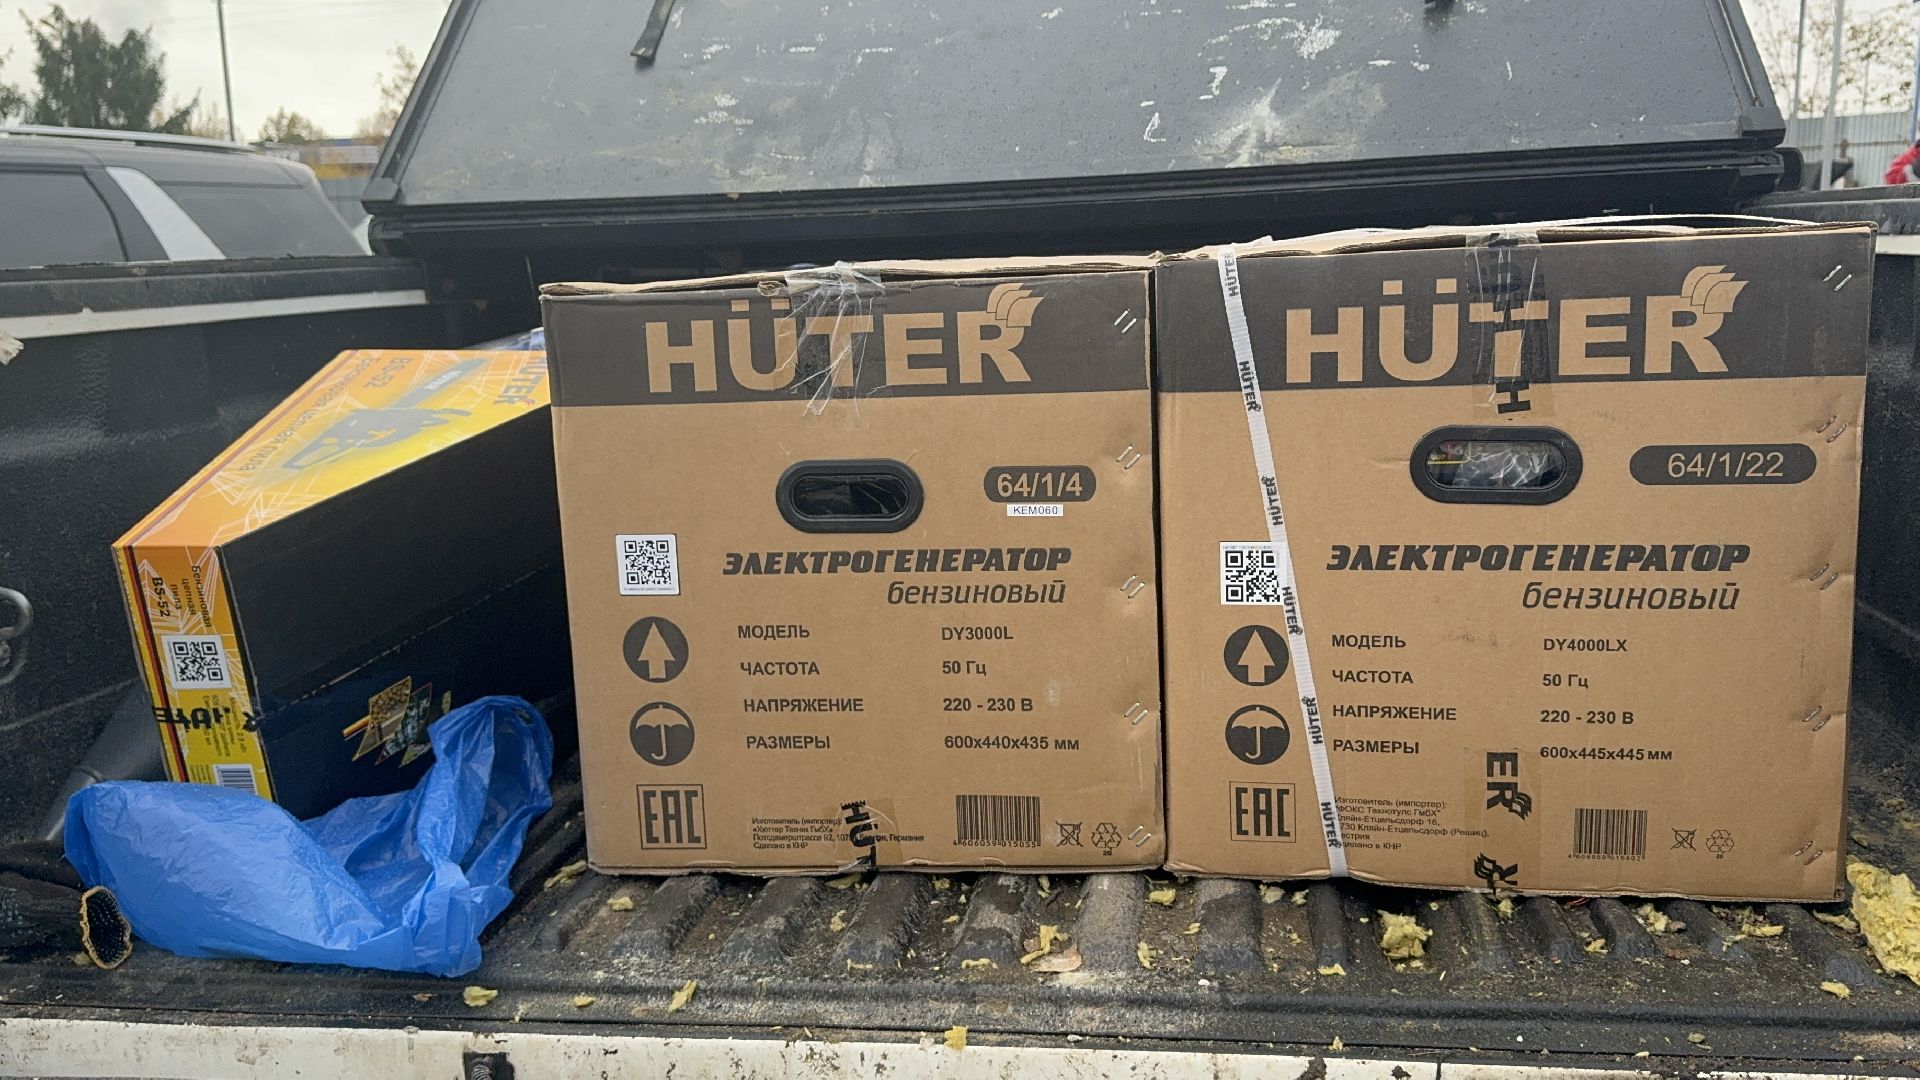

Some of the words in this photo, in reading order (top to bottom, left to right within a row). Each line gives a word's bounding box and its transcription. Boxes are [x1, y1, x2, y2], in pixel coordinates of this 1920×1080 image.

[1286, 265, 1749, 384] HÜTER
[645, 282, 1044, 393] HÜTER
[1238, 360, 1262, 412] HÜTER
[1667, 453, 1785, 478] 64/1/22
[997, 472, 1082, 498] 64/1/4
[1261, 476, 1284, 526] HÜTER
[723, 547, 1071, 576] ЭЛЕКТРОГЕНЕРАТОР
[1326, 543, 1750, 572] ЭЛЕКТРОГЕНЕРАТОР
[152, 576, 171, 617] BS-52
[888, 580, 1066, 605] бензиновый
[1523, 581, 1739, 610] бензиновый
[1281, 586, 1304, 636] HÜTER
[738, 624, 810, 641] МОДЕЛЬ
[942, 626, 1014, 641] DY3000L
[1332, 634, 1407, 650] МОДЕЛЬ
[1544, 638, 1628, 652] DY4000LX
[741, 661, 820, 676] ЧАСТОТА
[943, 661, 962, 675] 50
[966, 661, 987, 677] Гц
[1333, 669, 1414, 684] ЧАСТОТА
[1543, 674, 1562, 687] 50
[1568, 674, 1589, 690] Гц
[744, 698, 864, 713] НАПРЯЖЕНИЕ
[943, 698, 972, 712] 220
[987, 698, 1016, 712] 230
[1333, 705, 1457, 721] НАПРЯЖЕНИЕ
[1301, 695, 1324, 744] HÜTER
[1540, 710, 1571, 724] 220
[1587, 710, 1616, 725] 230
[746, 735, 831, 750] РАЗМЕРЫ
[1055, 740, 1080, 751] мм
[1333, 739, 1420, 754] РАЗМЕРЫ
[1648, 751, 1673, 761] мм
[1395, 799, 1447, 809] (импортер):
[1320, 801, 1343, 849] HÜTER
